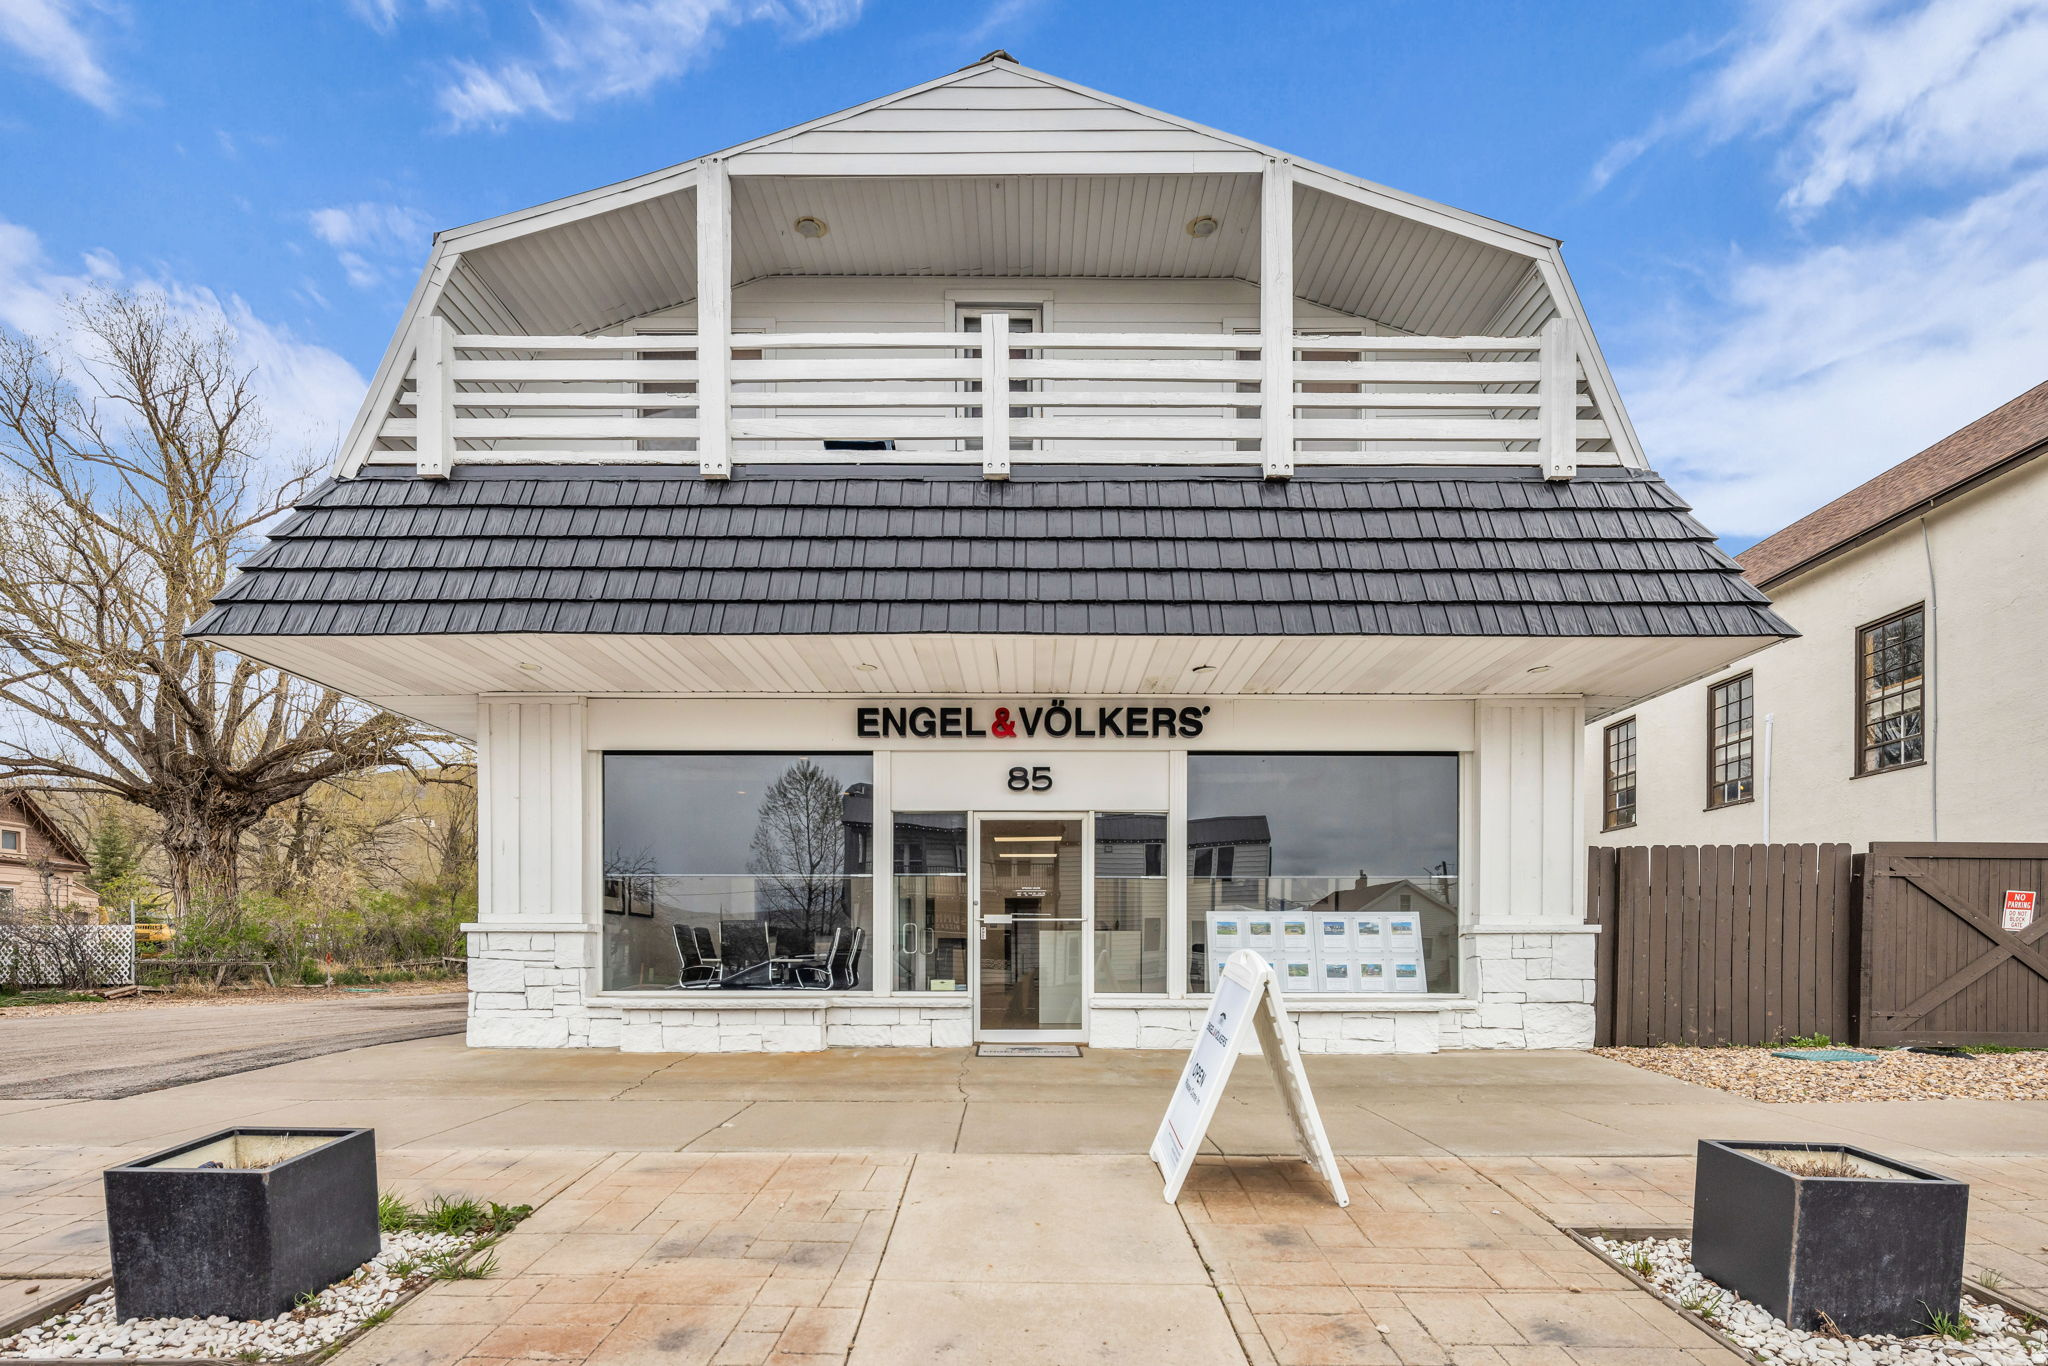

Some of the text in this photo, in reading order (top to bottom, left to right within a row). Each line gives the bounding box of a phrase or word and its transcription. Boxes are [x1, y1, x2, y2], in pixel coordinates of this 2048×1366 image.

[1007, 766, 1053, 791] 85
[2007, 901, 2031, 909] PARKING
[2014, 893, 2026, 901] NO
[1192, 1062, 1206, 1088] OPEN
